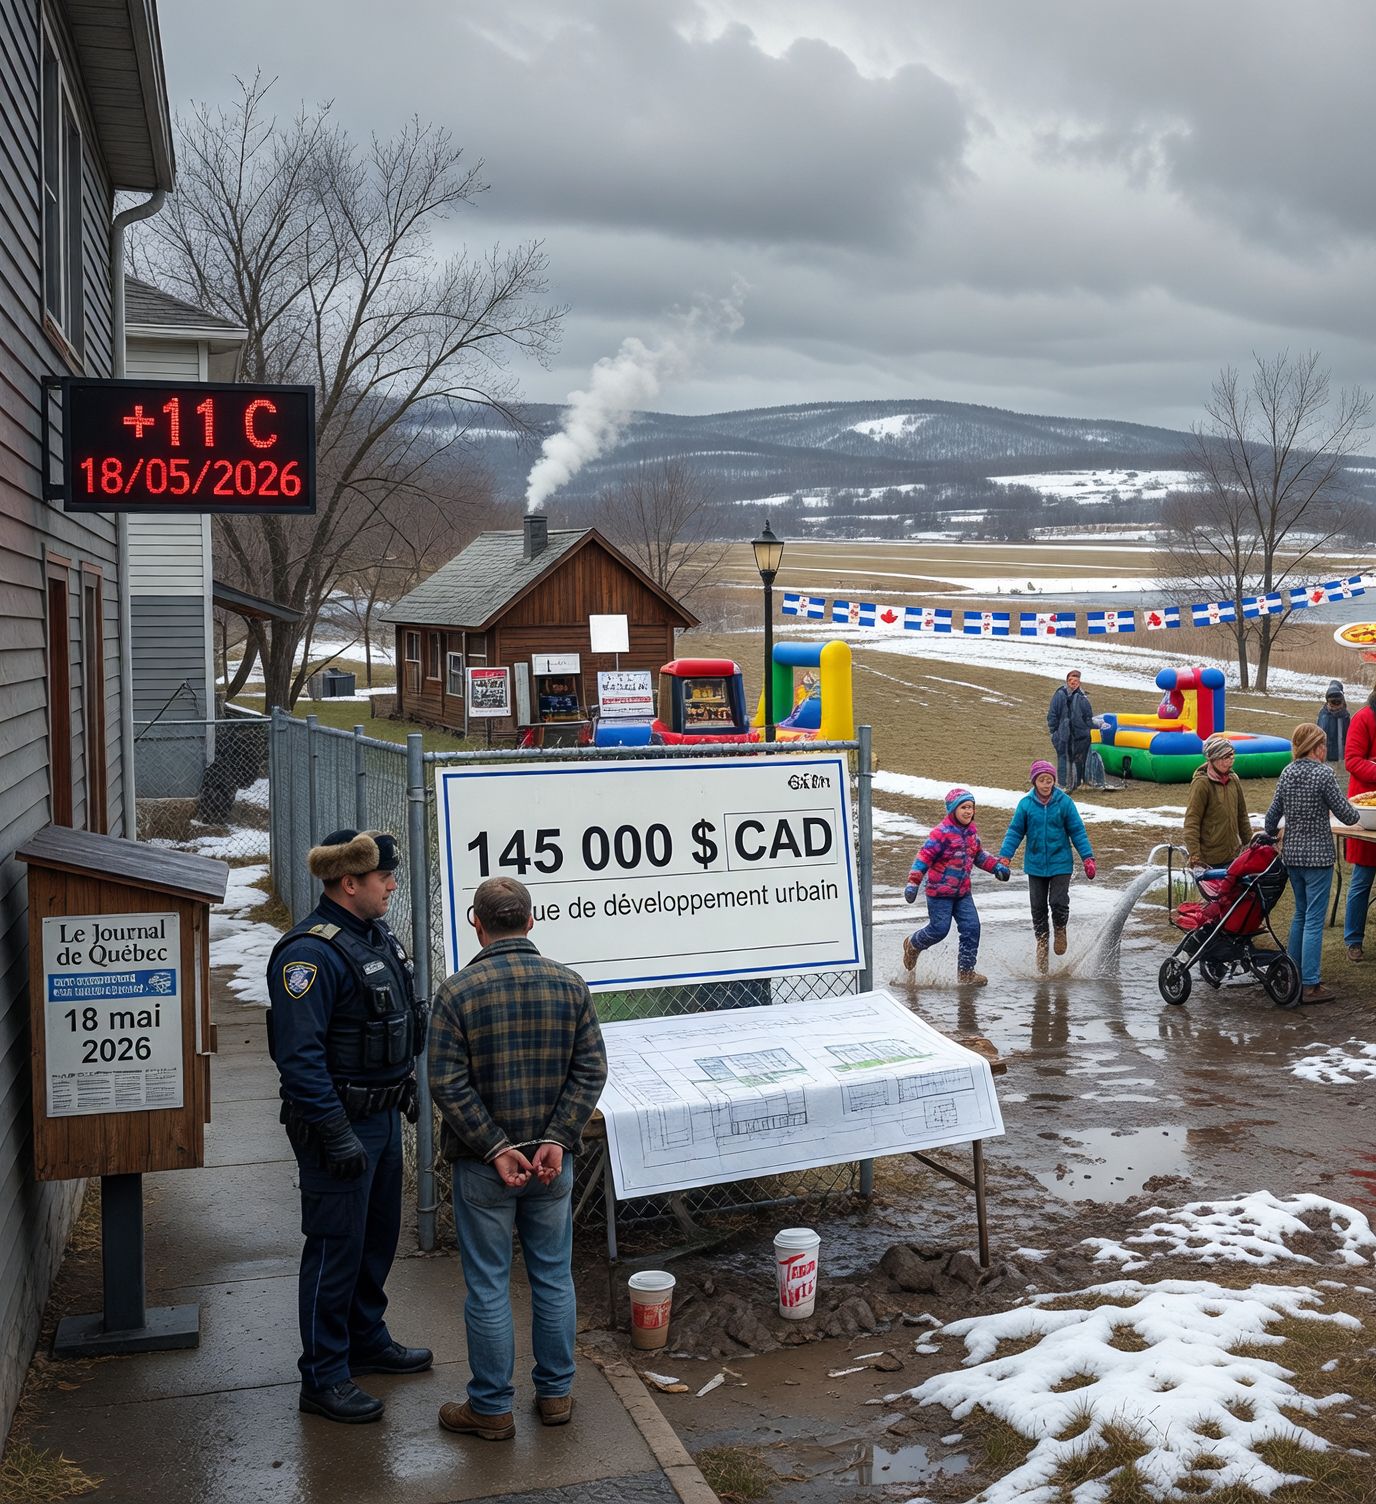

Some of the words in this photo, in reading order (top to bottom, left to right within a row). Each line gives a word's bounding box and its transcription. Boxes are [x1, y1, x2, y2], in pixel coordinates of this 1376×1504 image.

[124, 398, 214, 447] +11
[245, 400, 277, 448] C
[81, 458, 301, 496] 18/05/2026
[468, 829, 563, 877] 145
[582, 824, 672, 871] 000
[692, 819, 717, 869] $
[735, 818, 832, 861] CAD
[569, 897, 595, 918] de
[604, 886, 768, 916] développement
[776, 880, 837, 903] urbain
[60, 925, 85, 943] Le
[93, 919, 165, 946] Journal
[57, 947, 81, 965] de
[89, 942, 167, 967] Québec
[65, 1008, 98, 1032] 18
[110, 1004, 160, 1029] mai
[82, 1037, 151, 1063] 2026
